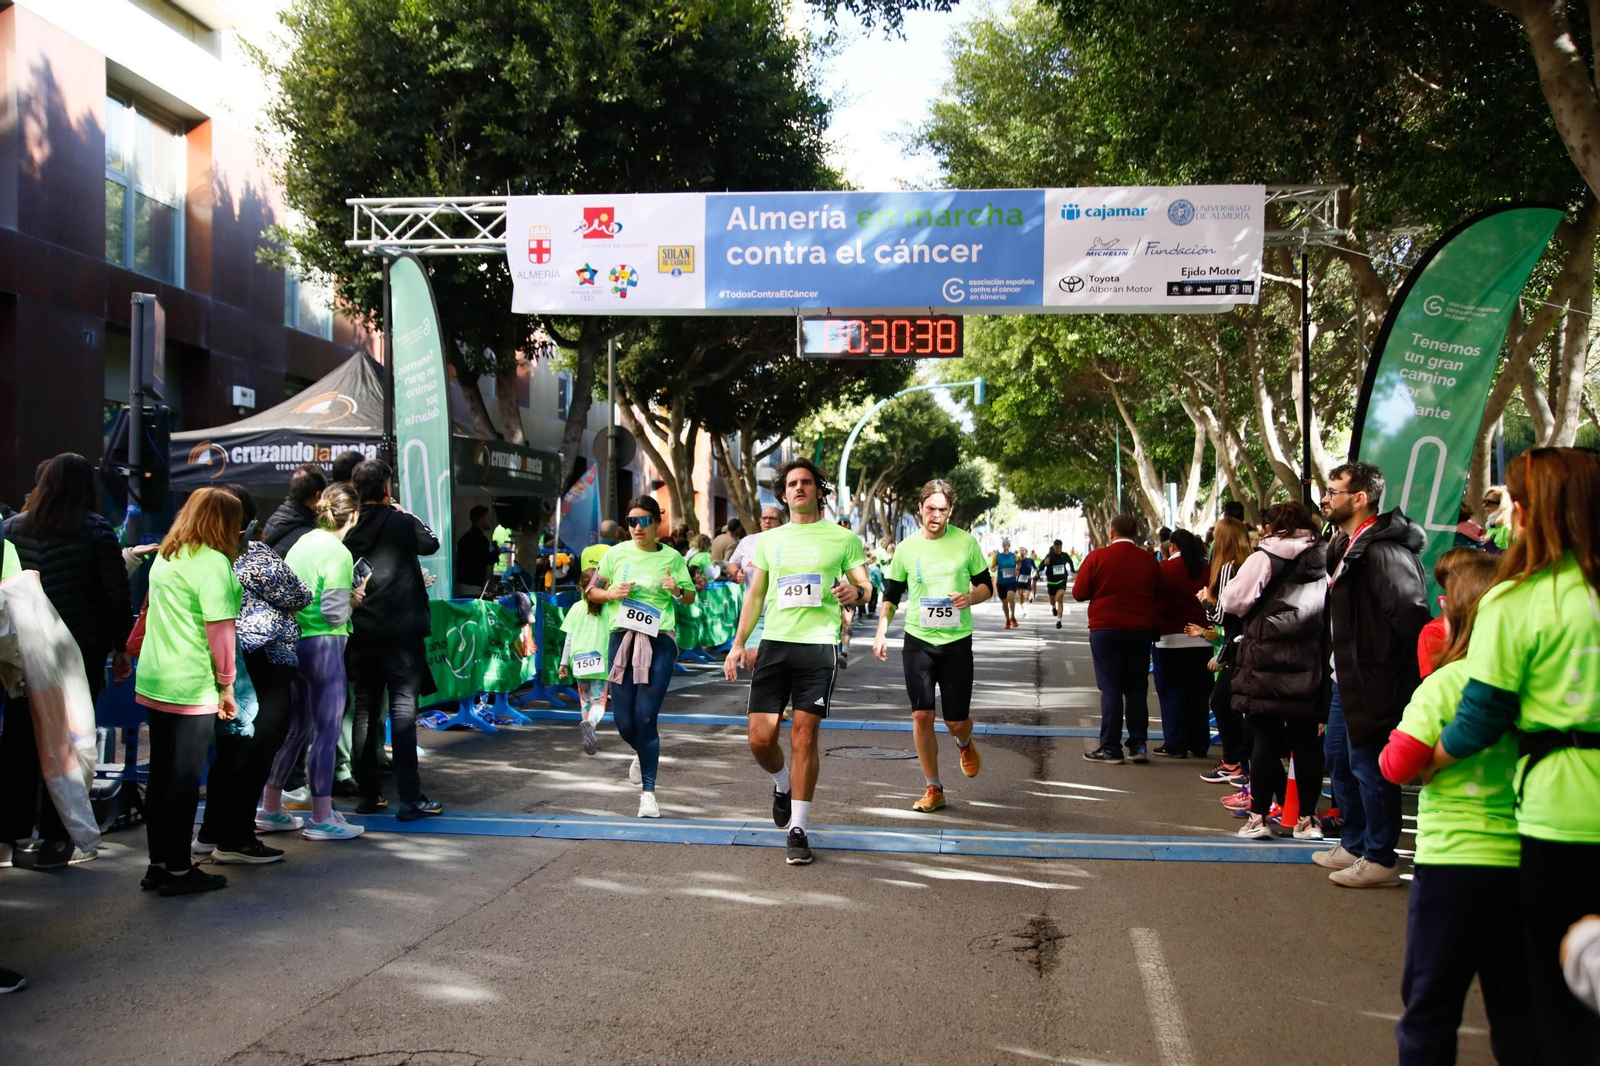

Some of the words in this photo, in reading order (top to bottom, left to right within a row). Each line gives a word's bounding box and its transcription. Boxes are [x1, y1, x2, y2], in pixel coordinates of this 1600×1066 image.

[726, 204, 846, 230] Almería
[857, 209, 893, 227] en
[905, 202, 1023, 227] marcha
[1085, 204, 1148, 221] cajamar
[662, 248, 690, 259] SOLAN
[726, 241, 826, 265] contra
[836, 239, 865, 264] el
[874, 238, 983, 264] cáncer
[1144, 241, 1216, 256] Fundación
[517, 269, 561, 280] ALMERÍA
[1181, 267, 1206, 278] Ejido
[1209, 266, 1240, 276] Motor
[1089, 275, 1120, 284] Toyota
[718, 290, 818, 299] #TodosContraElCáncer
[1215, 285, 1226, 294] FIAT
[1412, 332, 1481, 356] Tenemos
[1404, 351, 1425, 364] un
[1426, 357, 1464, 372] gran
[1399, 368, 1457, 387] camino
[784, 584, 812, 597] 491
[626, 608, 653, 624] 806
[928, 607, 952, 618] 755
[576, 658, 601, 668] 1507
